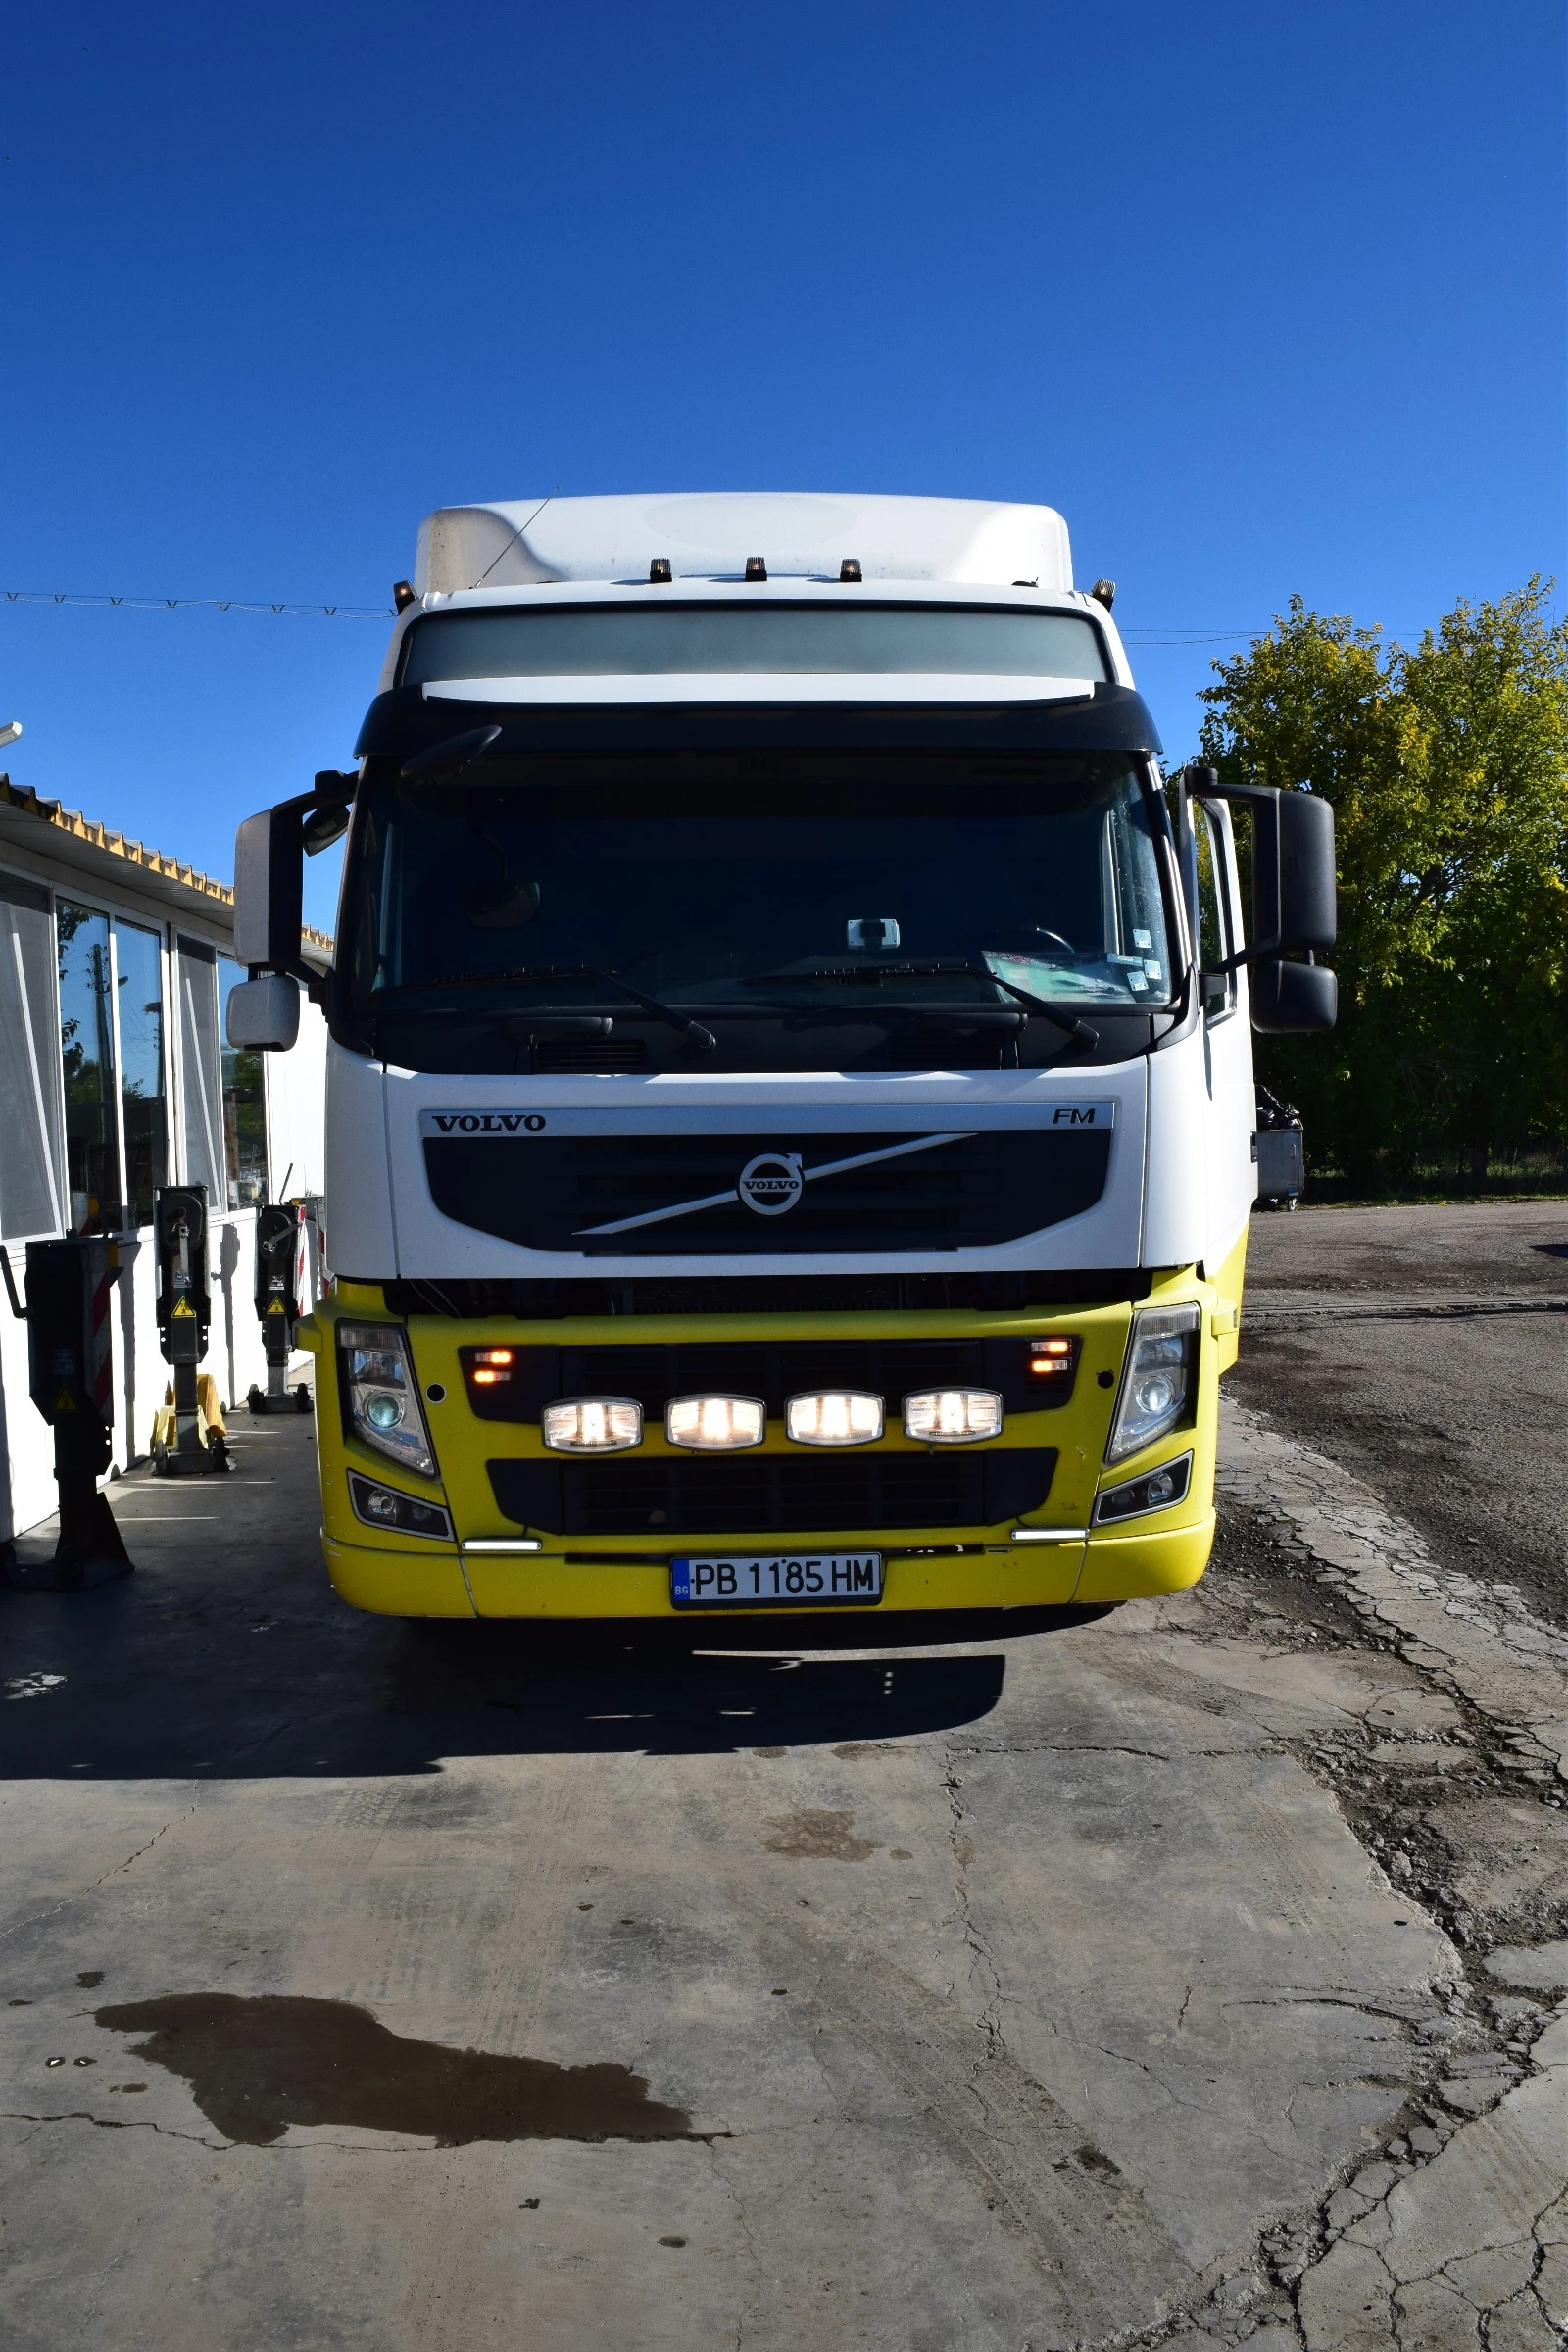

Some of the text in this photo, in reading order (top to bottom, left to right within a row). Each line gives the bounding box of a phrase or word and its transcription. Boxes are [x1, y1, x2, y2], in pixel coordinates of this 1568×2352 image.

[431, 1114, 547, 1132] VOLVO
[1053, 1108, 1096, 1125] FM
[742, 1180, 800, 1190] VOLVO
[695, 1559, 874, 1595] PB 1185 HM
[674, 1585, 689, 1595] BG
